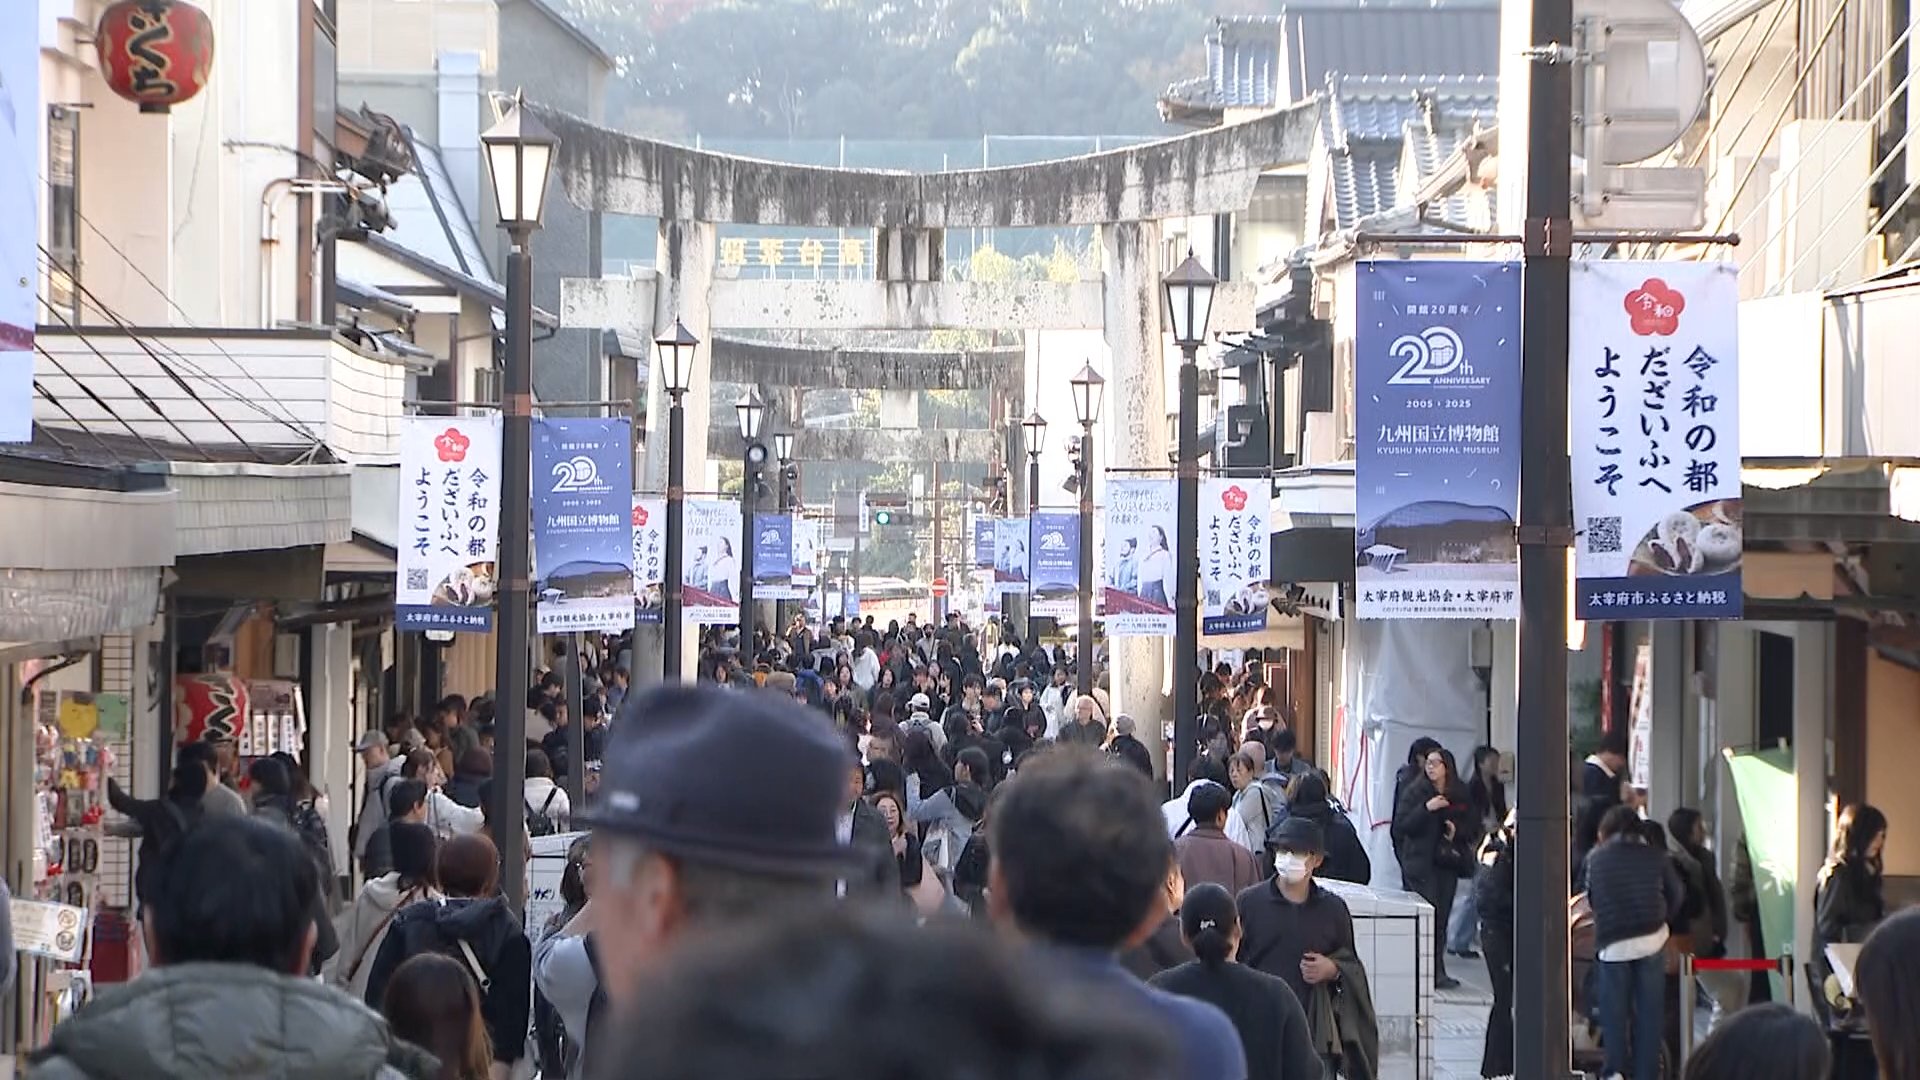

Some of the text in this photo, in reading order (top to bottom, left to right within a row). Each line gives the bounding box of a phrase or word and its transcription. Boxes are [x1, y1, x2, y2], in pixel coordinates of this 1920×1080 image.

[1406, 304, 1469, 316] 開館20周年
[1635, 293, 1674, 318] 令和
[1406, 399, 1472, 408] 2005 2025
[1433, 376, 1492, 385] ANNIVERSARY
[1376, 424, 1500, 443] 九州国立博物館
[1593, 346, 1624, 496] ようこそ
[1638, 346, 1672, 494] だざいふへ
[1681, 344, 1719, 494] 令和の都
[1376, 446, 1500, 455] KYUSHU NATIONAL MUSEUM
[413, 467, 432, 557] ようこそ
[439, 468, 461, 556] だざいふへ
[466, 467, 488, 557] 令和の都
[546, 513, 620, 528] 九州国立博物館
[647, 529, 659, 581] 令和の都
[1209, 515, 1221, 582] ようこそ
[1228, 515, 1242, 581] だざいふへ
[1247, 514, 1261, 578] 令和の都
[1588, 590, 1728, 607] 太宰府市ふるさと納税
